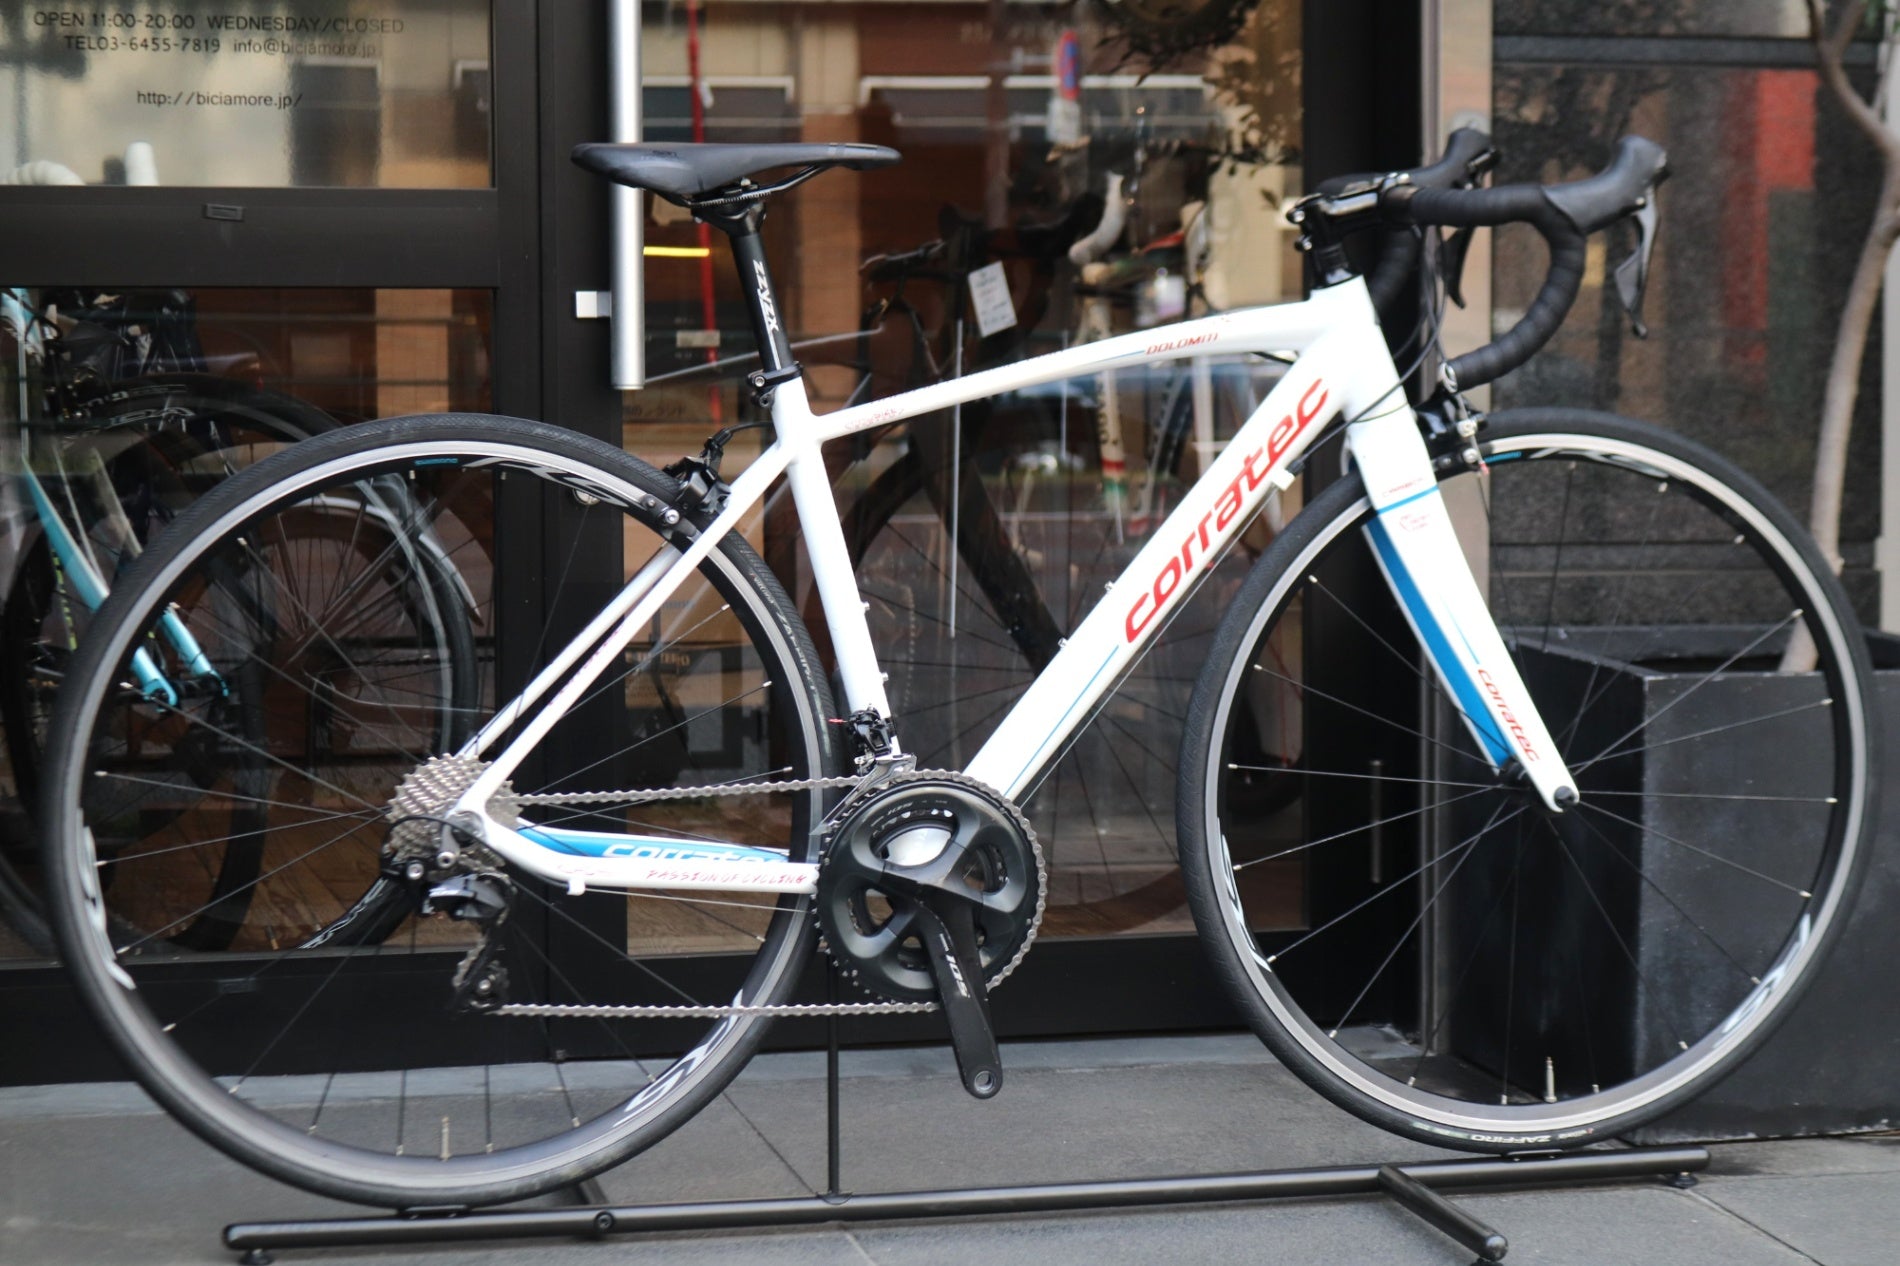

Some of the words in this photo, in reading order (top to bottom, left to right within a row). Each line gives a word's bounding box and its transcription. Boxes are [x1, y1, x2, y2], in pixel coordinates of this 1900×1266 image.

[34, 11, 85, 27] OPEN
[92, 13, 195, 29] 11:00-20:00
[207, 15, 404, 34] WEDNESDAY/CLOSED
[233, 39, 377, 58] info@biciamore.jp
[137, 90, 303, 110] http://biciamore.jp/
[1125, 378, 1329, 643] corratec
[1478, 669, 1541, 762] corratec
[1470, 1134, 1552, 1144] ZAFFIRO
